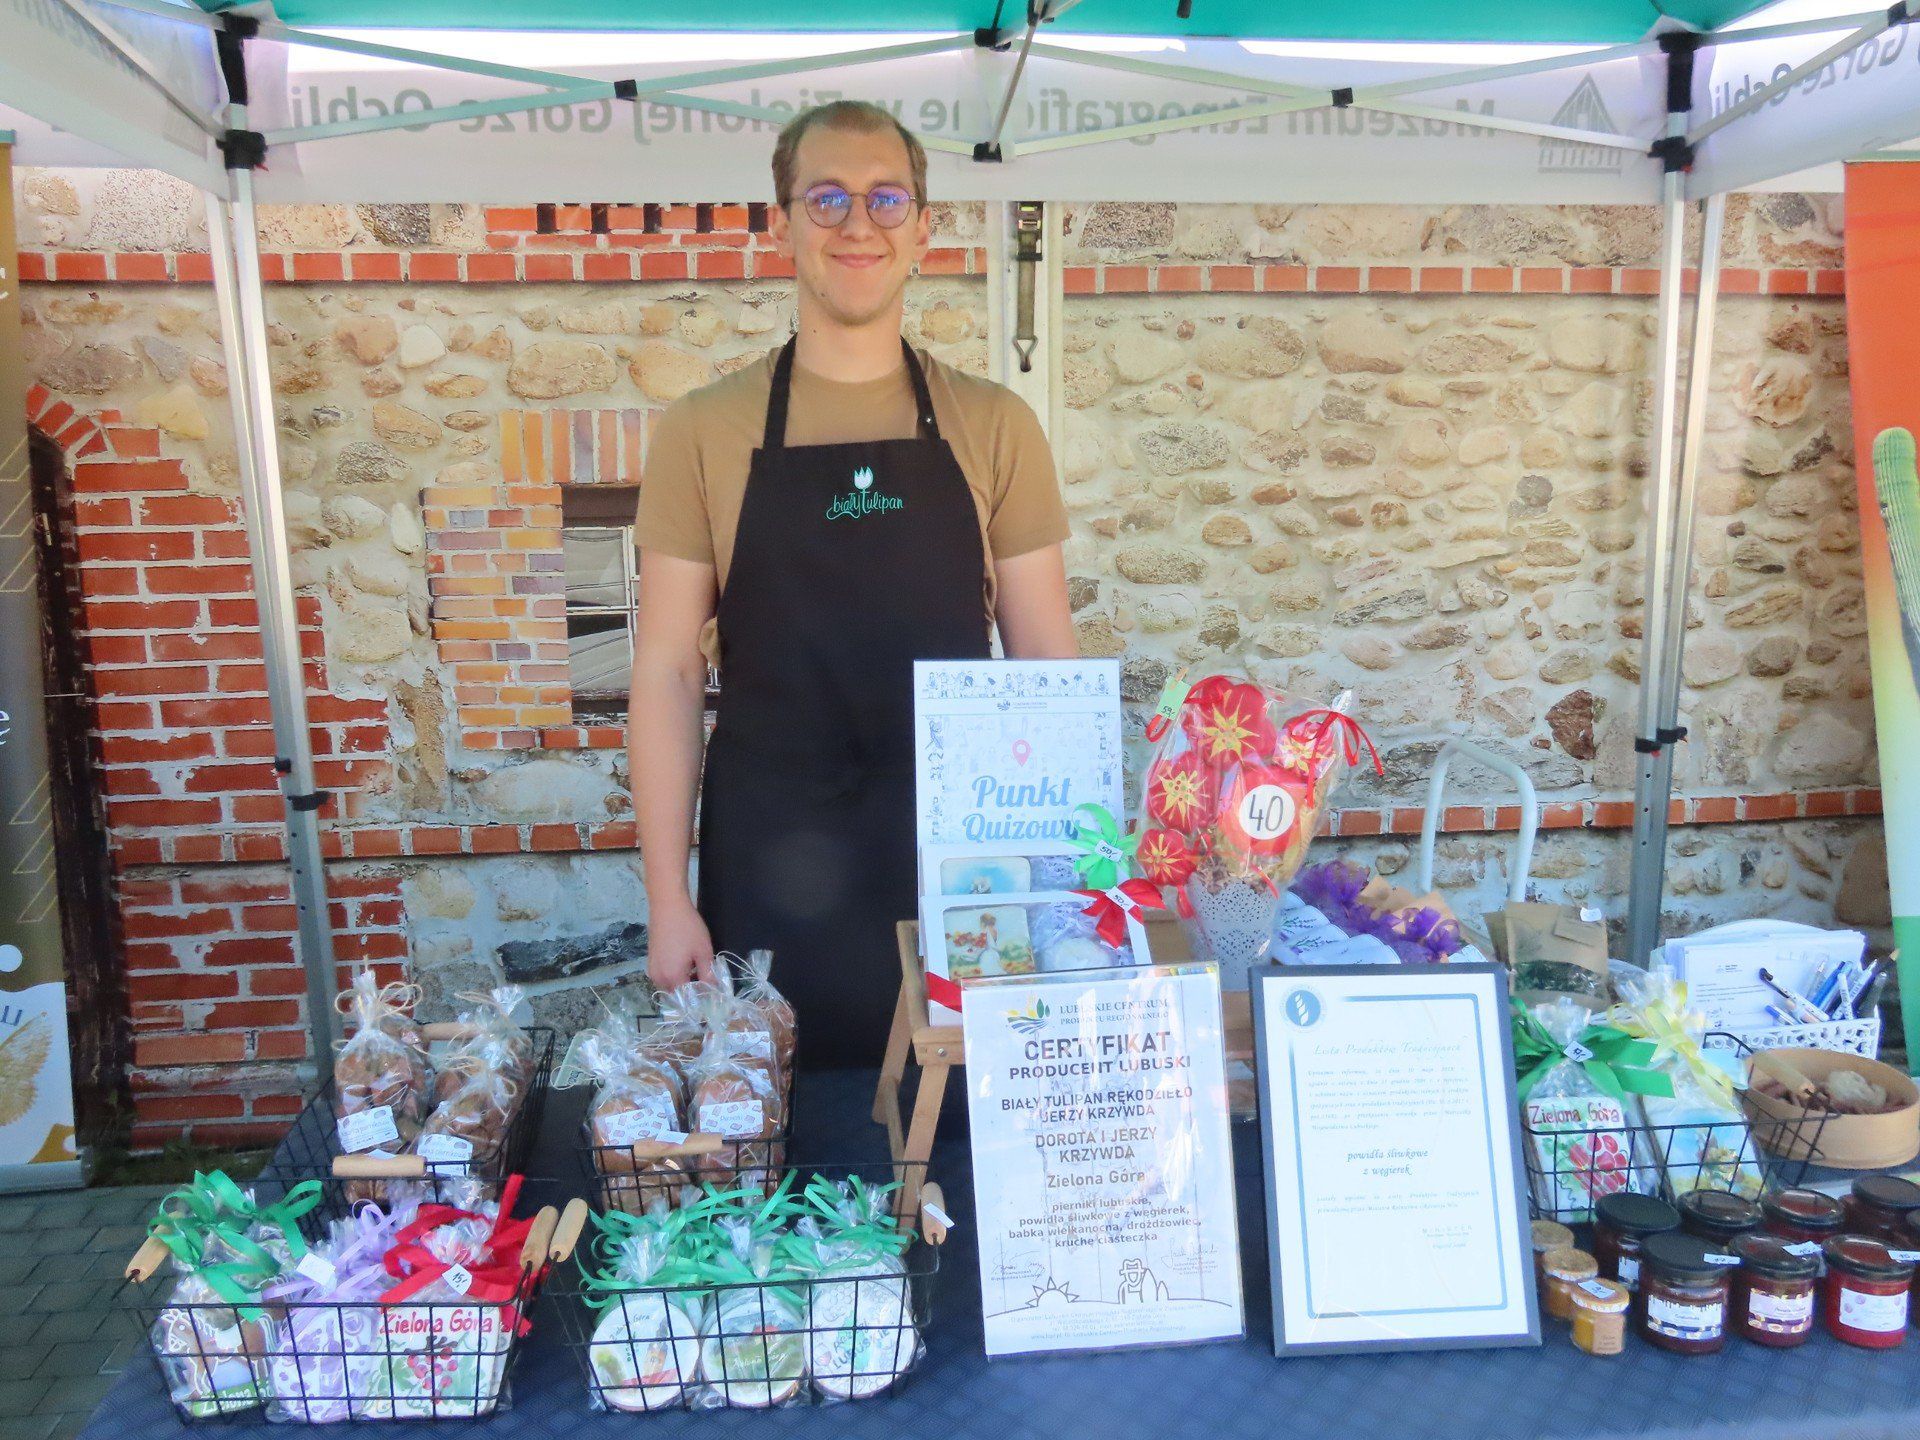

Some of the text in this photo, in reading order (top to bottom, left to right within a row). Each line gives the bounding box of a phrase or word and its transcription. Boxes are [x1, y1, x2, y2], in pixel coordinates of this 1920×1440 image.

[972, 775, 1072, 808] Punkt
[1249, 794, 1284, 832] 40
[962, 813, 1080, 843] Quizowy
[1060, 1002, 1112, 1015] LUBKIE
[1024, 1031, 1171, 1061] CERTYFIKAT
[1009, 1055, 1191, 1080] PRODUCENT LUBUSKI
[1001, 1086, 1193, 1111] BIAŁY TULIPAN RĘKODZIEŁO
[1041, 1104, 1156, 1123] JERZY KRZYWDA
[1529, 1102, 1620, 1124] Zielona Góra
[1035, 1126, 1157, 1149] DOROTA I JERZY
[1059, 1145, 1136, 1163] KRZYWDA
[1347, 1147, 1429, 1163] powidła śliwkowe
[1047, 1173, 1104, 1189] Zielona
[1362, 1165, 1412, 1178] z węgierek
[1019, 1214, 1064, 1228] powidła
[1067, 1210, 1121, 1223] śliwkowe
[1133, 1204, 1190, 1219] węgierek,
[1052, 1195, 1152, 1214] pierniki lubuskie,
[1008, 1216, 1202, 1239] babka wielkanocna, drożdżowiec,
[1055, 1231, 1158, 1248] kruche ciasteczka
[380, 1308, 493, 1334] Zielona Góra
